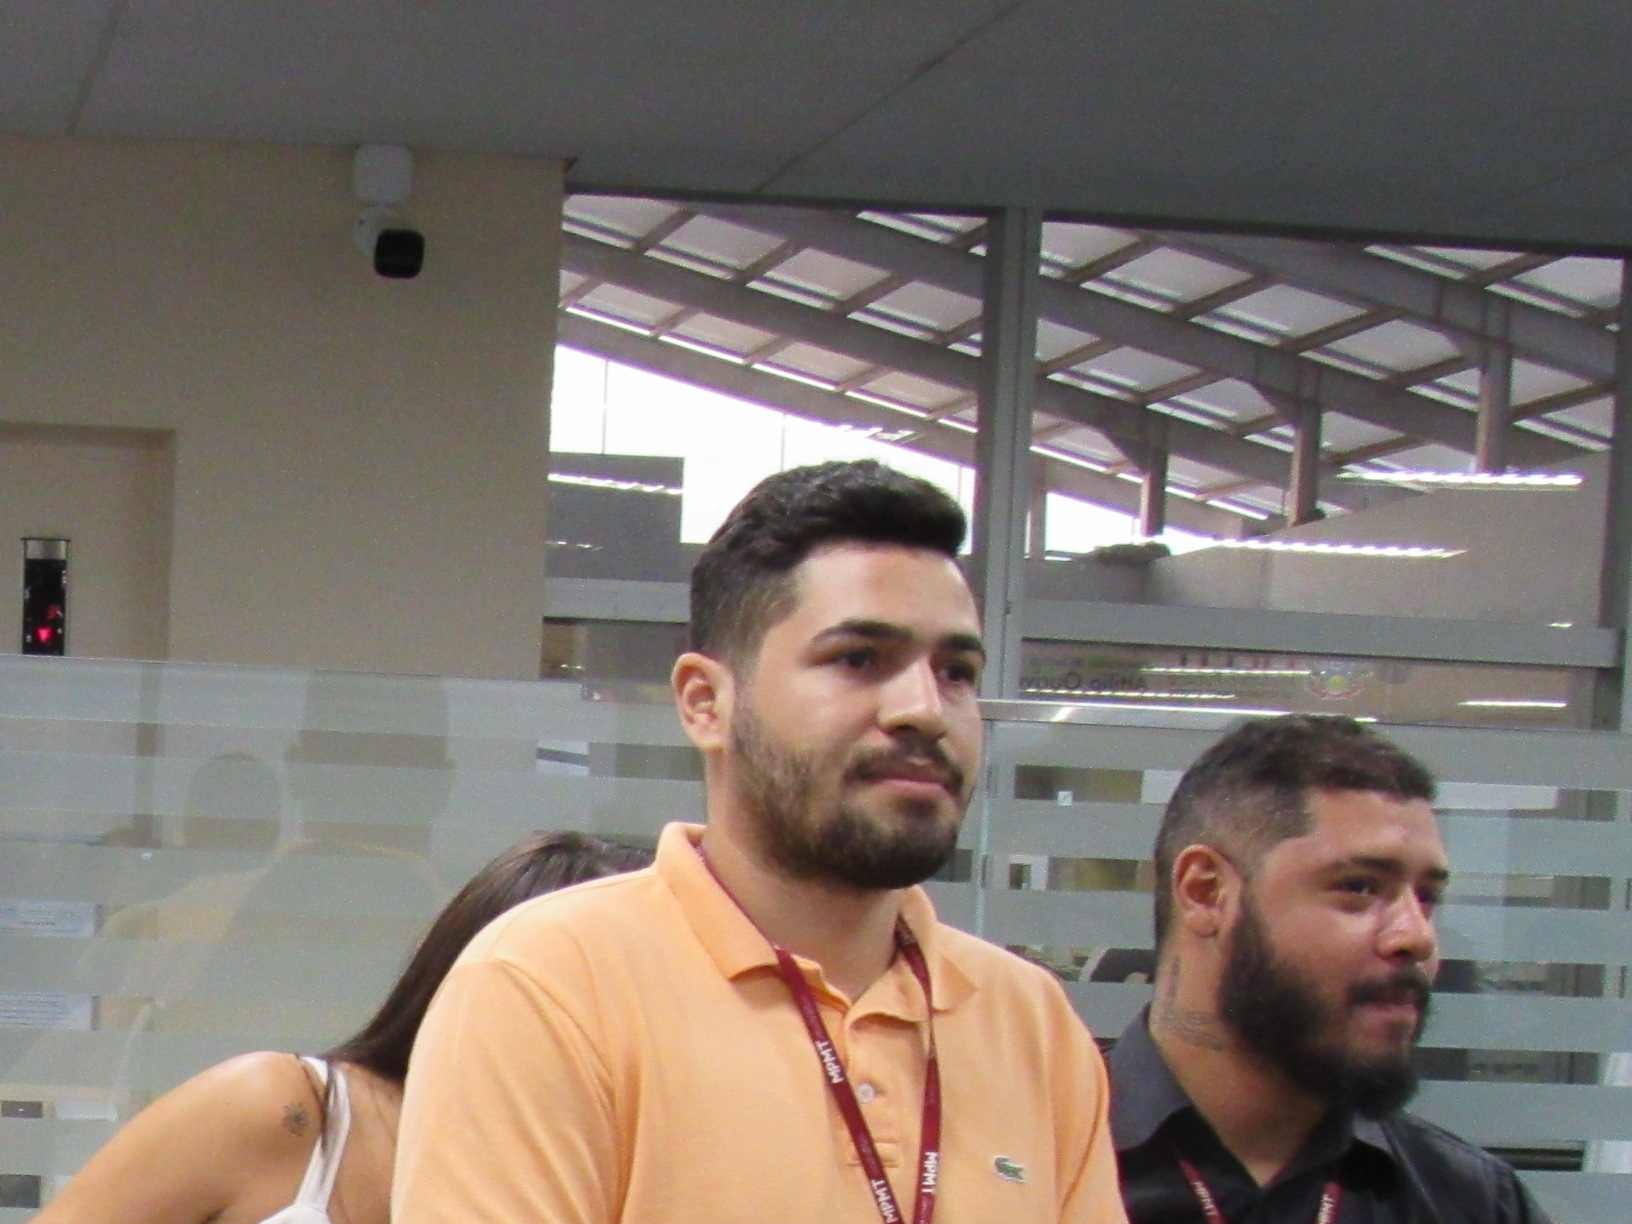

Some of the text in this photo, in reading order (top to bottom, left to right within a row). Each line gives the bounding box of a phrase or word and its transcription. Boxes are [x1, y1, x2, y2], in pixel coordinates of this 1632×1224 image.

[814, 1040, 844, 1084] MPMT
[921, 1151, 939, 1193] MPMT
[871, 1179, 898, 1224] MPMT
